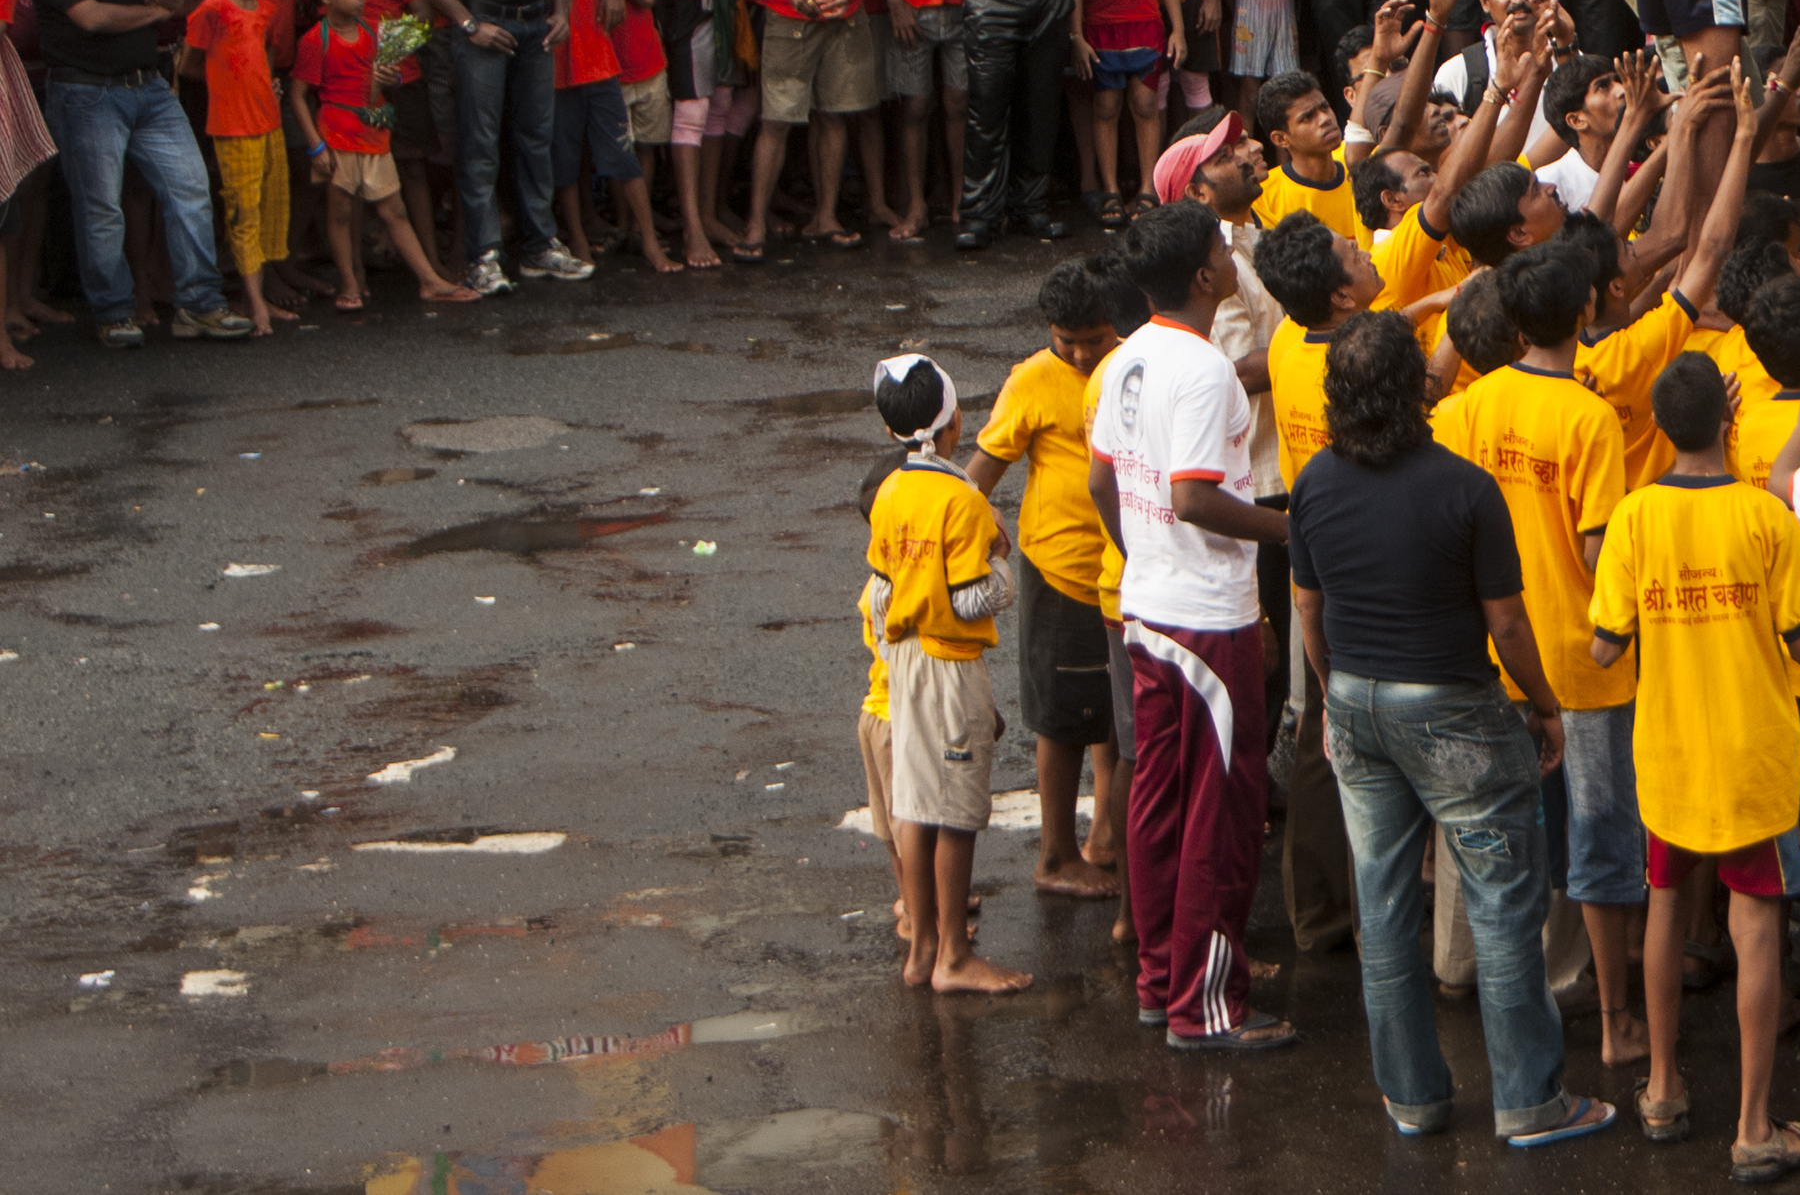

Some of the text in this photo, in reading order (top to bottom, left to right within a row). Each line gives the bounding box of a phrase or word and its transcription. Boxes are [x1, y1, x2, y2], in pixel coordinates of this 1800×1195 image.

[1678, 564, 1717, 582] सौजन्य
[1643, 578, 1760, 612] श्री. भरत चव्हाण
